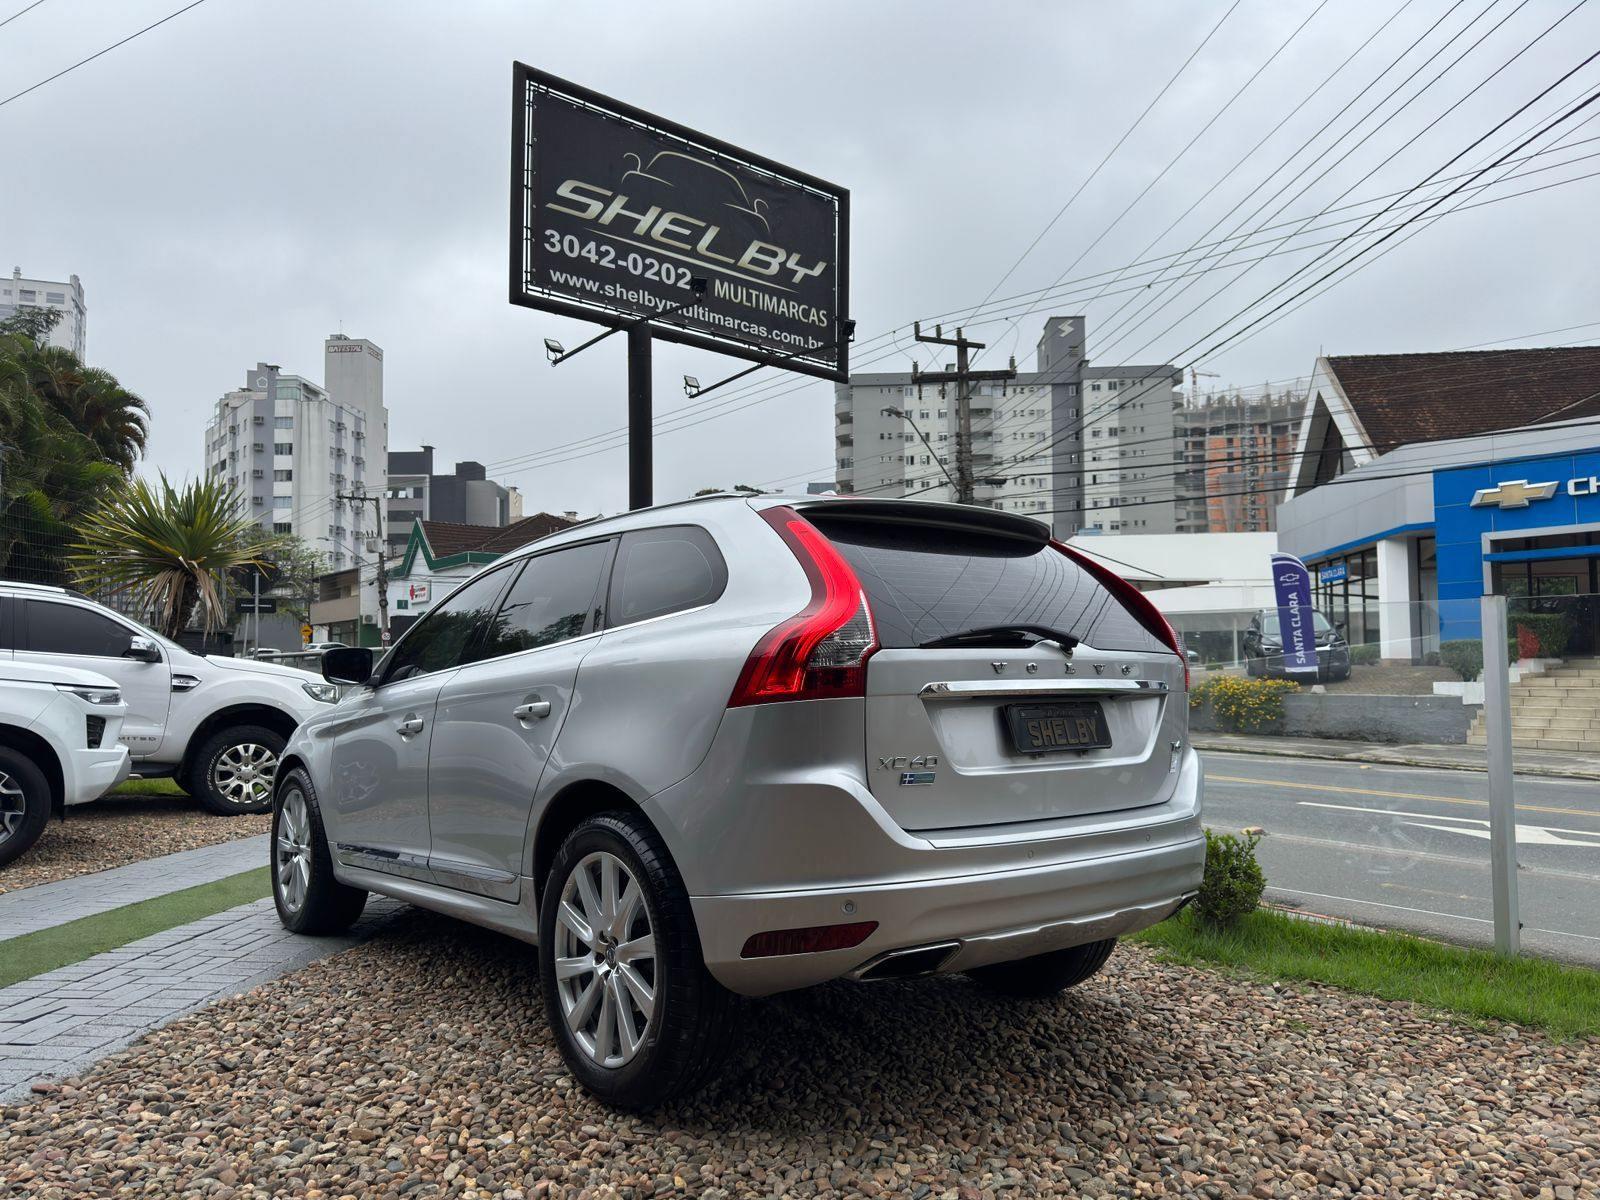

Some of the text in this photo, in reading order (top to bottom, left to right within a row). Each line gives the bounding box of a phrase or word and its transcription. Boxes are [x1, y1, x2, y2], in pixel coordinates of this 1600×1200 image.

[545, 179, 827, 283] SHELBY
[544, 229, 693, 289] 3042-0202
[714, 279, 828, 328] MULTIMARCAS
[1288, 592, 1301, 627] CLARA
[1293, 629, 1306, 664] SANTA
[991, 662, 1131, 676] VOLVO
[1027, 718, 1098, 747] SHELBY
